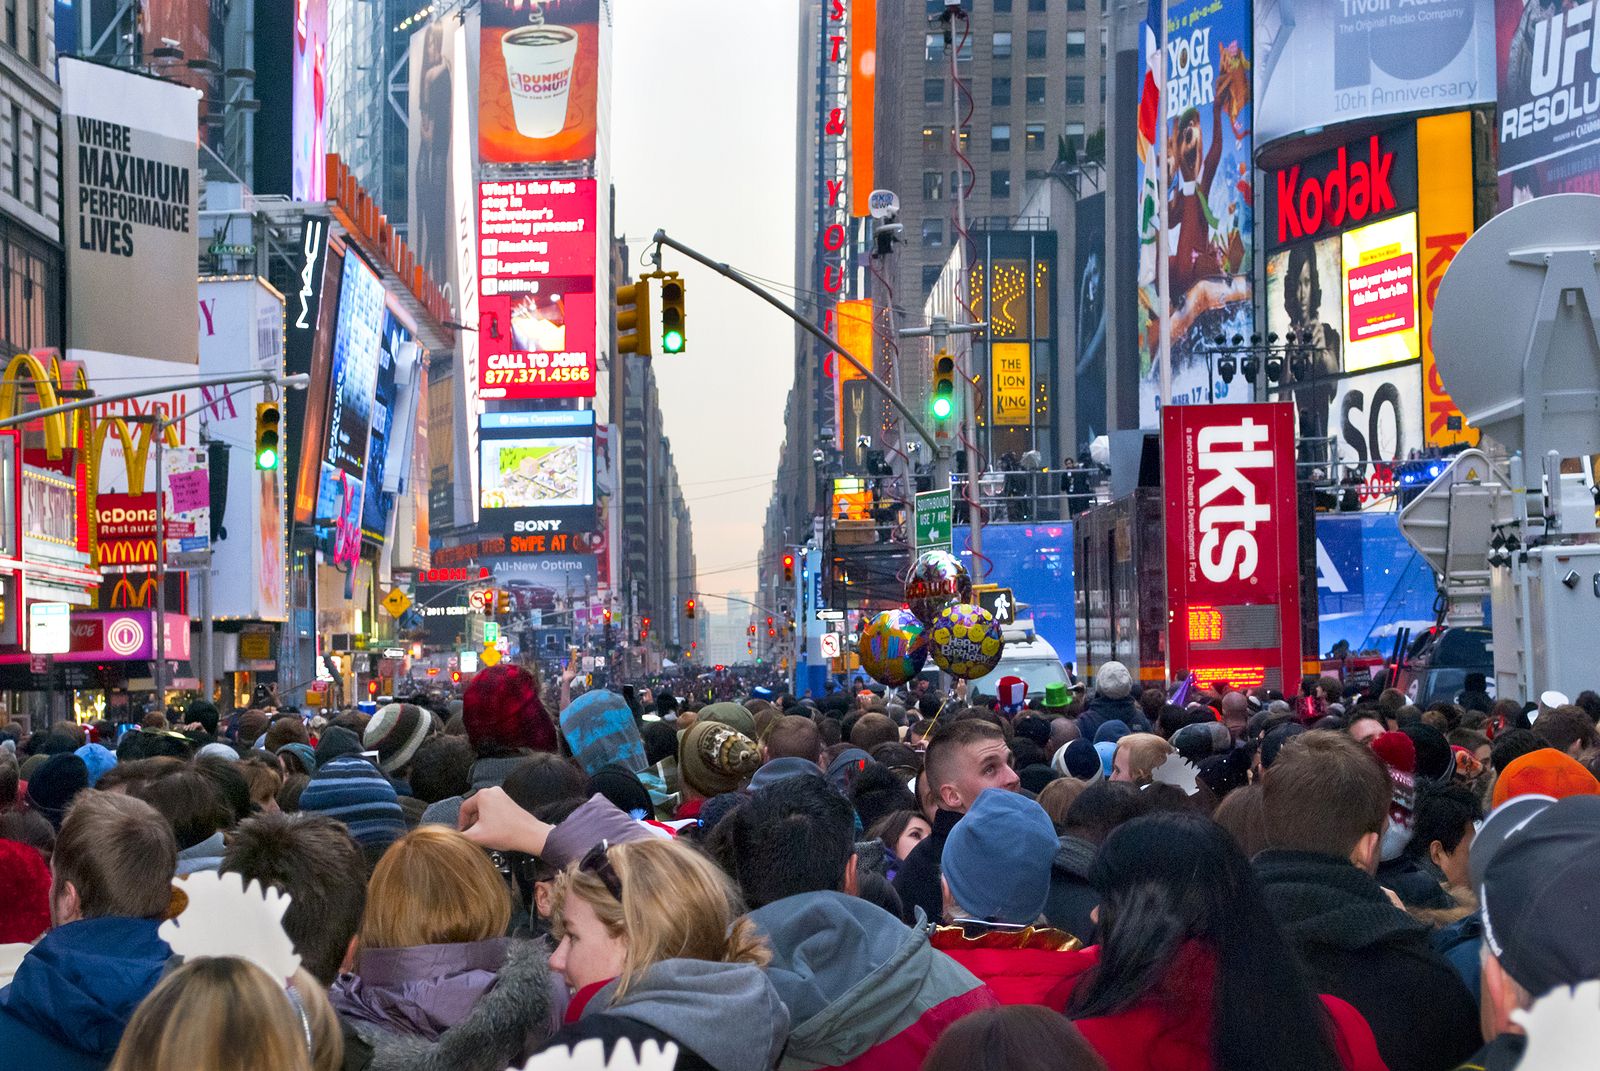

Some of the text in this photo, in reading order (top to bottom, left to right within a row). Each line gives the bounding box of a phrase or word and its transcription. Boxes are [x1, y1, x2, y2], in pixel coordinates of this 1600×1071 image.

[1339, 23, 1355, 34] The
[1389, 12, 1416, 26] Radio
[1417, 8, 1464, 22] Company
[1167, 27, 1211, 80] YOGI
[523, 78, 568, 93] DONUTS
[1167, 64, 1215, 119] BEAR
[1334, 80, 1478, 112] 10th Anniversary
[826, 107, 845, 135] &
[77, 115, 131, 153] WHERE
[79, 144, 190, 206] MAXIMUM
[481, 180, 576, 196] What is the first
[1277, 134, 1396, 243] Kodak
[79, 186, 189, 233] PERFORMANCE
[481, 195, 522, 210] step in
[79, 215, 134, 258] LIVES
[481, 218, 585, 236] brewing process?
[487, 351, 587, 369] CALL TO JOIN
[1001, 358, 1022, 370] THE
[484, 367, 590, 385] 877.371.4566
[997, 374, 1025, 392] LION
[1191, 386, 1202, 404] 17
[1215, 380, 1229, 399] 3D
[997, 395, 1027, 415] KING
[1186, 466, 1194, 475] of
[1187, 476, 1195, 507] Theatre
[1197, 417, 1275, 583] tkts
[513, 519, 562, 532] SONY
[920, 513, 930, 525] USE
[932, 512, 936, 524] 7
[511, 535, 546, 553] SWIPE
[550, 534, 568, 552] AT
[1187, 508, 1196, 560] Development
[494, 559, 583, 573] All-New Optima
[1189, 562, 1197, 582] Fund
[949, 636, 982, 653] Happy
